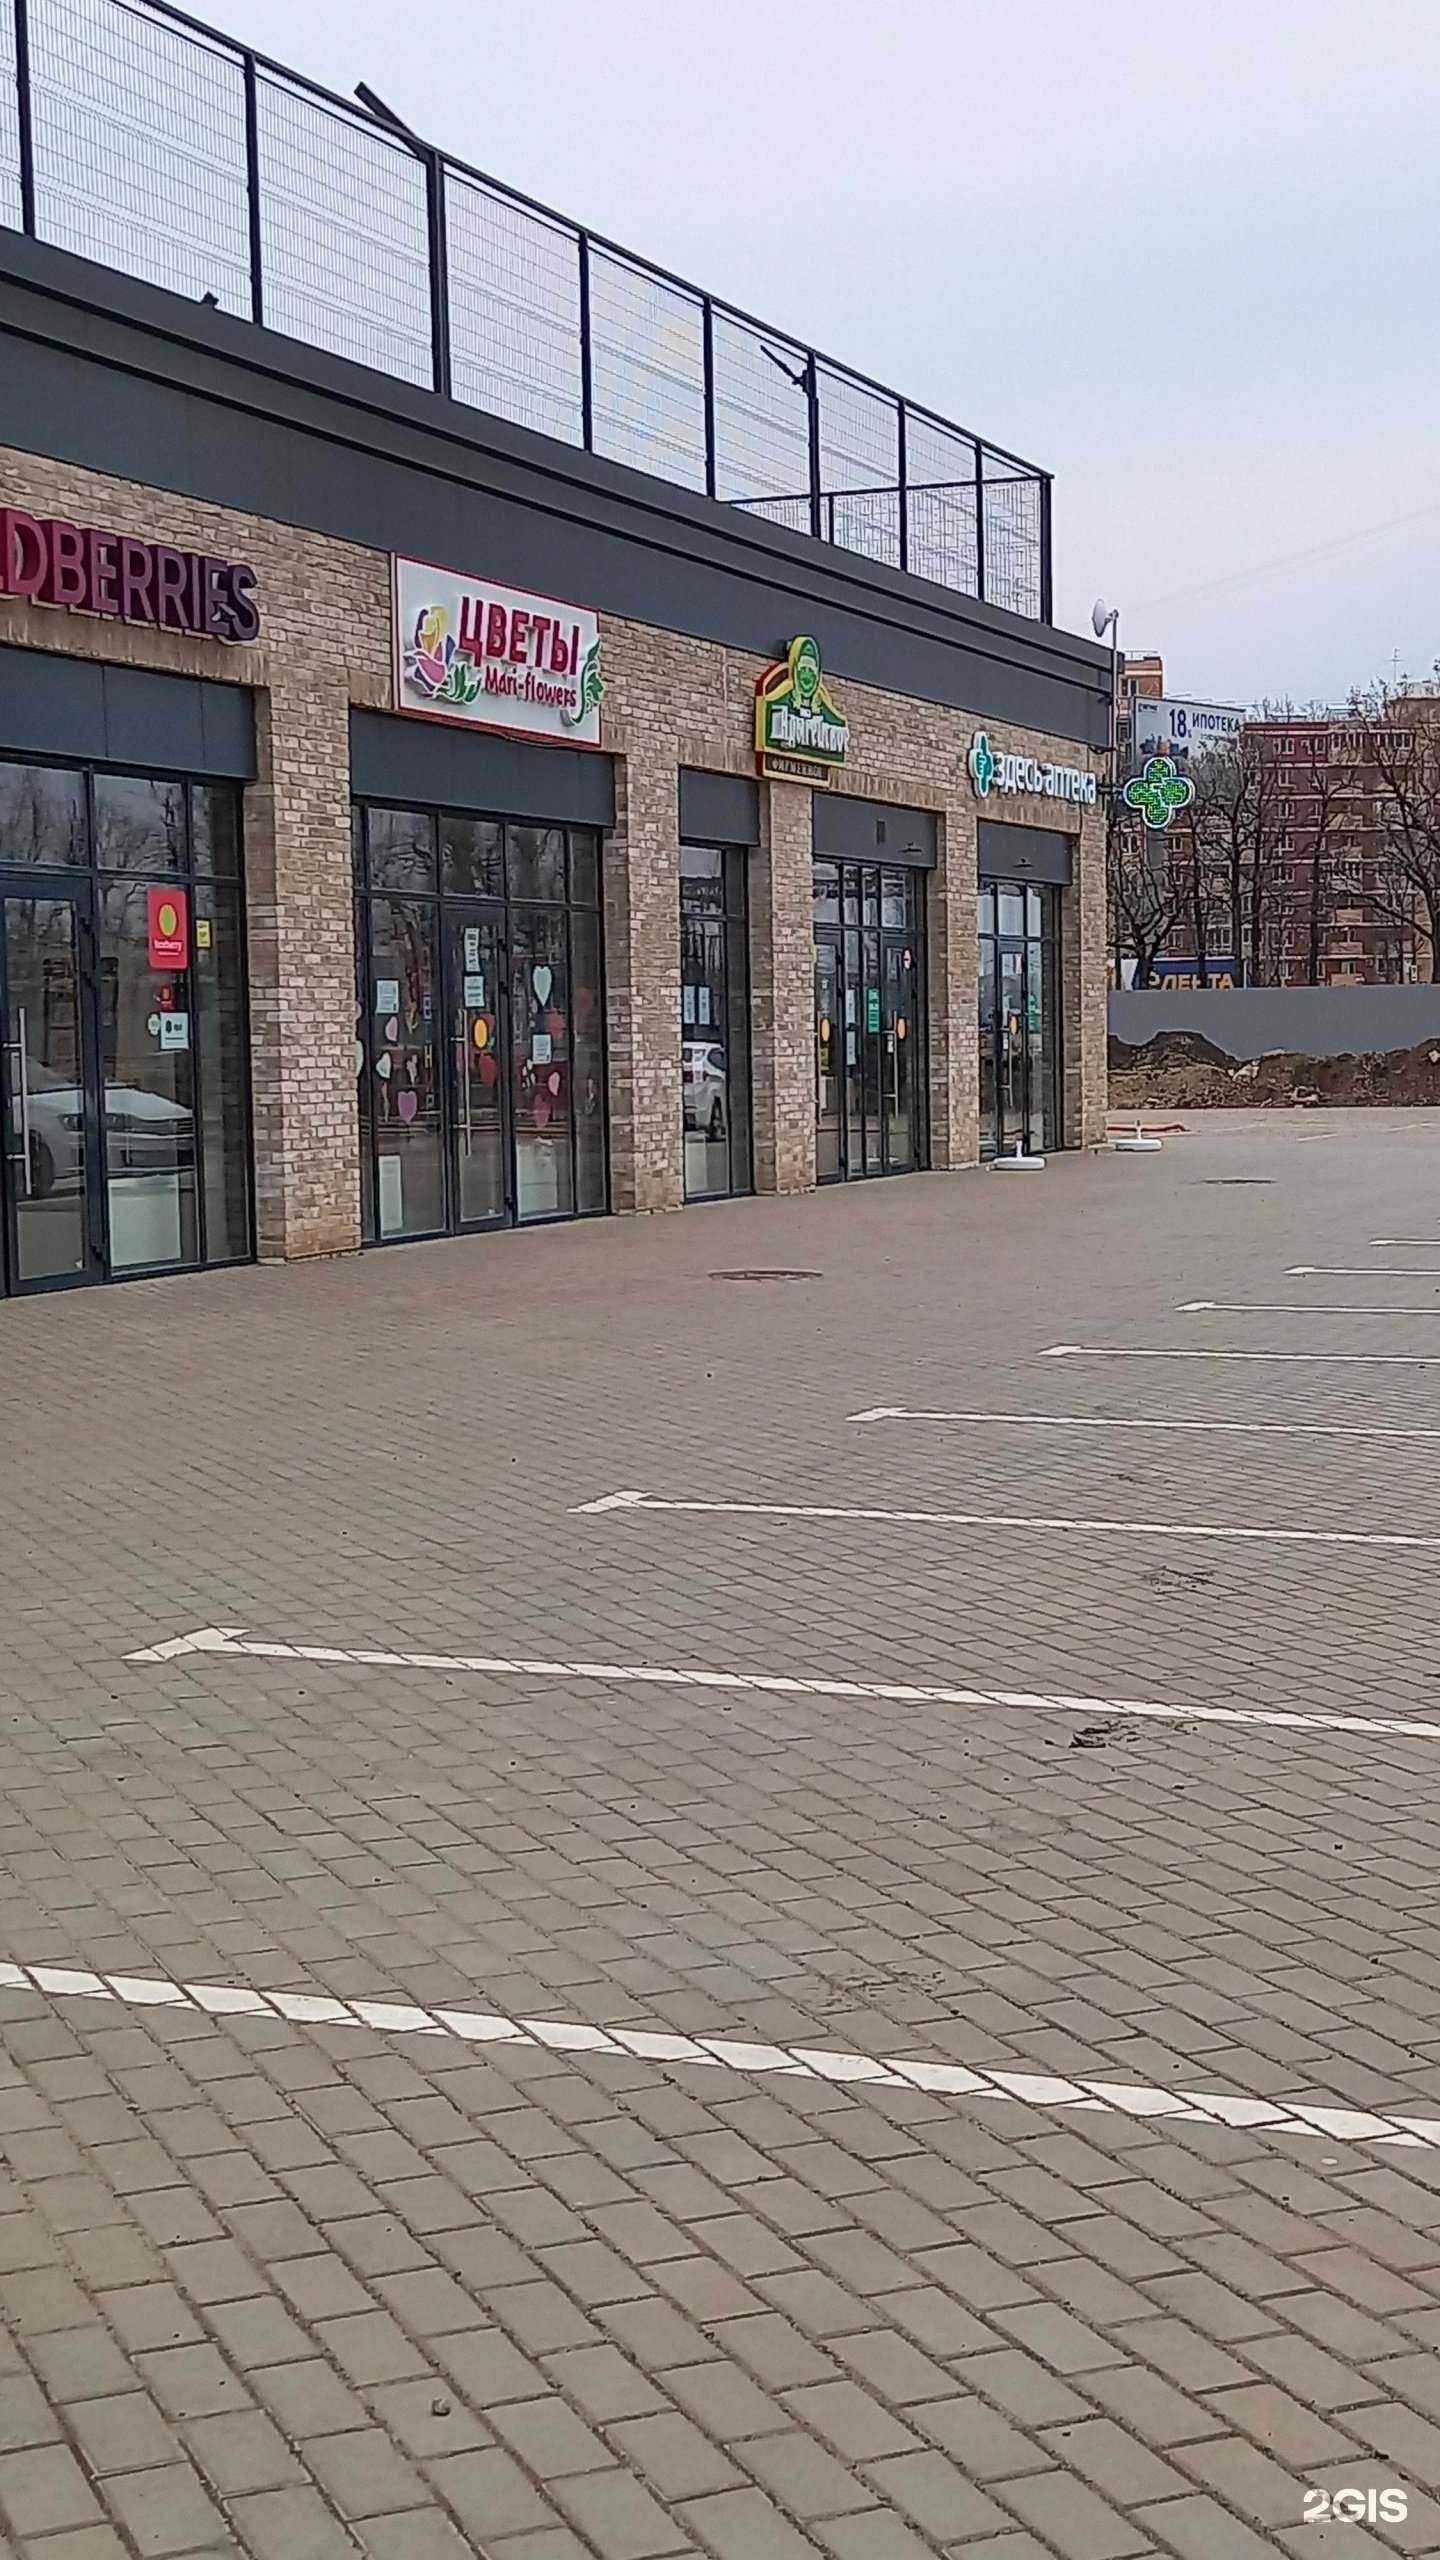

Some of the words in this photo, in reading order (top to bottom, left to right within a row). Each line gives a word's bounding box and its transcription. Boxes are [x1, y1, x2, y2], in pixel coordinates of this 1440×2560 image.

[0, 507, 260, 640] DBERRIES
[459, 596, 580, 676] ЦВЕТЫ
[485, 665, 577, 708] Mari-flowers
[1192, 712, 1240, 733] ИПОТЕКА
